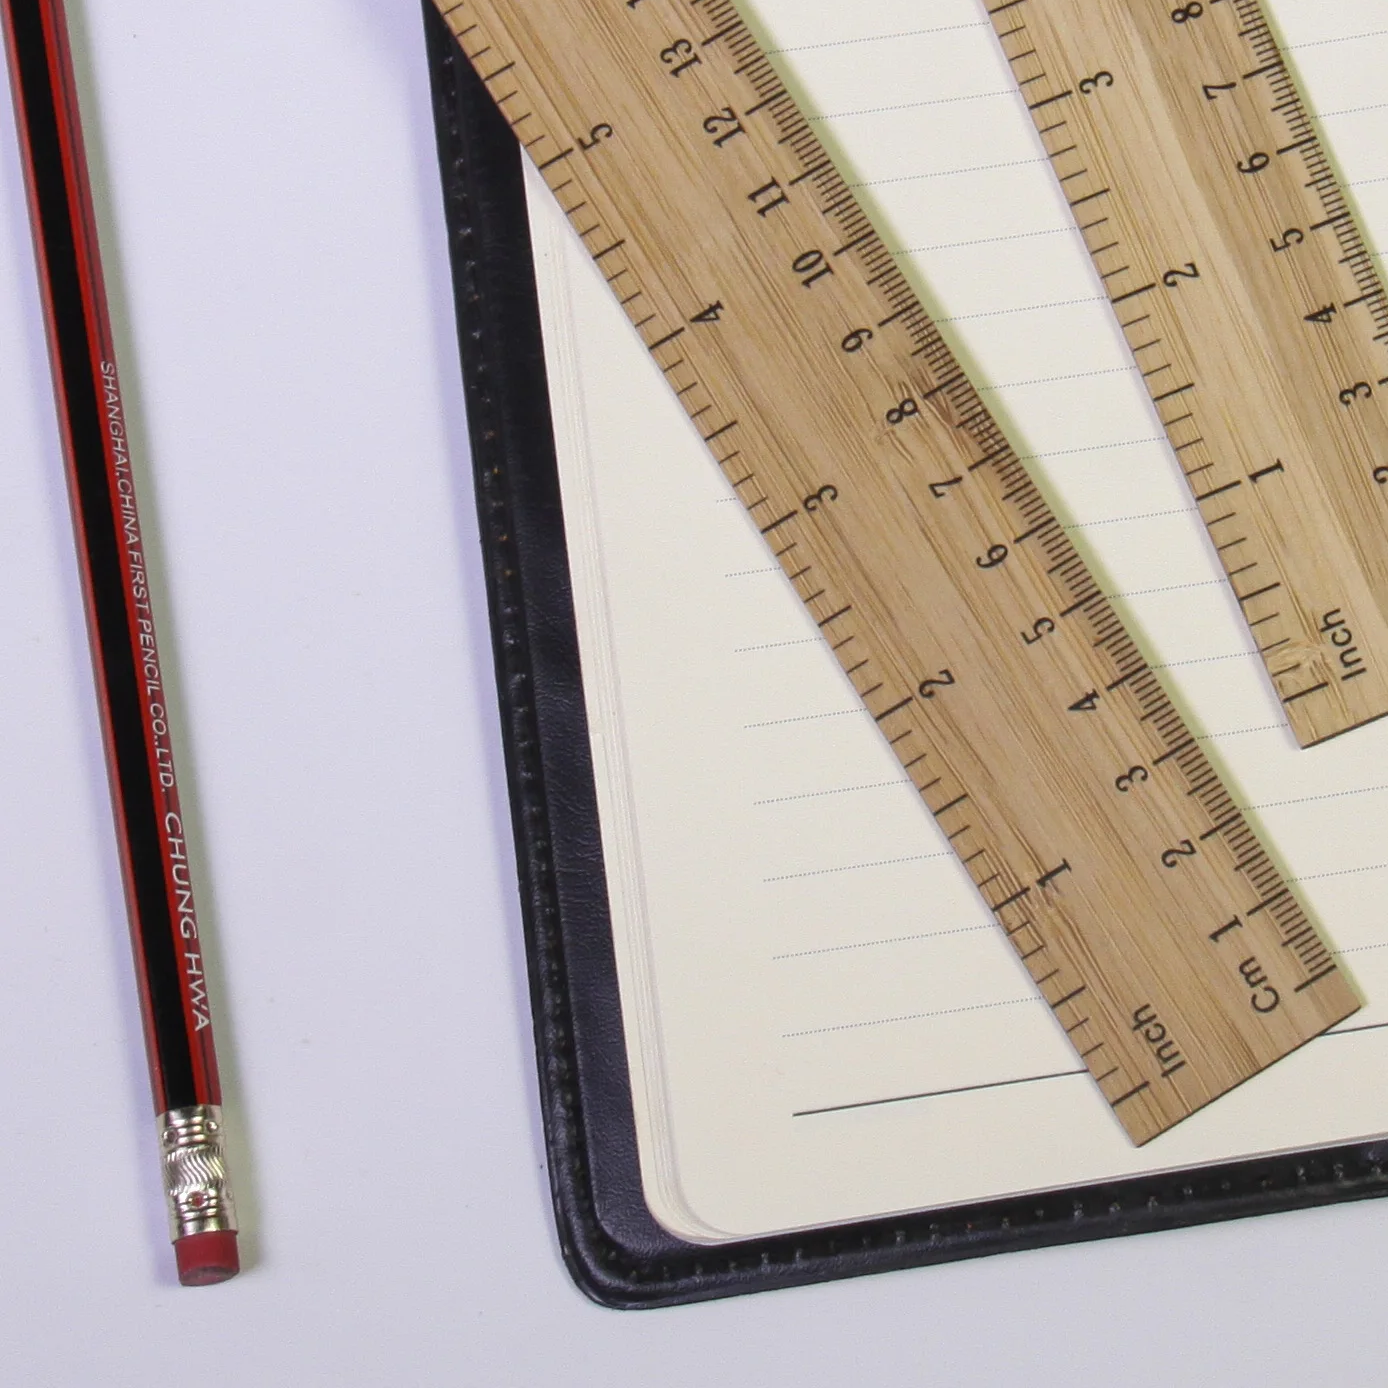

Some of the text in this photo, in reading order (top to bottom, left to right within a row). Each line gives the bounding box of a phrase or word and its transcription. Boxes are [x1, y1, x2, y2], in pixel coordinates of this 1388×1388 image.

[1171, 1, 1204, 27] 8
[660, 38, 702, 78] 13
[1078, 71, 1114, 94] 3
[1202, 82, 1237, 102] 7
[575, 123, 613, 151] 5
[703, 105, 748, 148] 12
[1235, 152, 1270, 178] 6
[747, 176, 790, 218] 11
[1269, 227, 1305, 252] 5
[792, 249, 834, 288] 10
[1161, 262, 1200, 288] 2
[690, 299, 725, 323] 4
[1303, 301, 1336, 325] 4
[841, 324, 873, 353] 9
[1338, 380, 1374, 407] 3
[885, 398, 919, 425] 8
[928, 474, 963, 498] 7
[1247, 458, 1284, 486] 1
[803, 484, 838, 512] 3
[976, 542, 1008, 568] 6
[128, 549, 150, 615] FIRST
[1020, 617, 1055, 645] 5
[1319, 607, 1368, 682] Inch
[138, 618, 160, 697] PENCIL
[919, 669, 955, 699] 2
[1068, 688, 1100, 712] 4
[1115, 765, 1148, 792] 3
[1161, 839, 1196, 868] 2
[1035, 856, 1073, 892] 1
[165, 812, 210, 1032] CHUNG HWA
[1208, 915, 1243, 943] 1
[1238, 956, 1281, 1014] Cm
[1133, 1003, 1186, 1080] Inch
